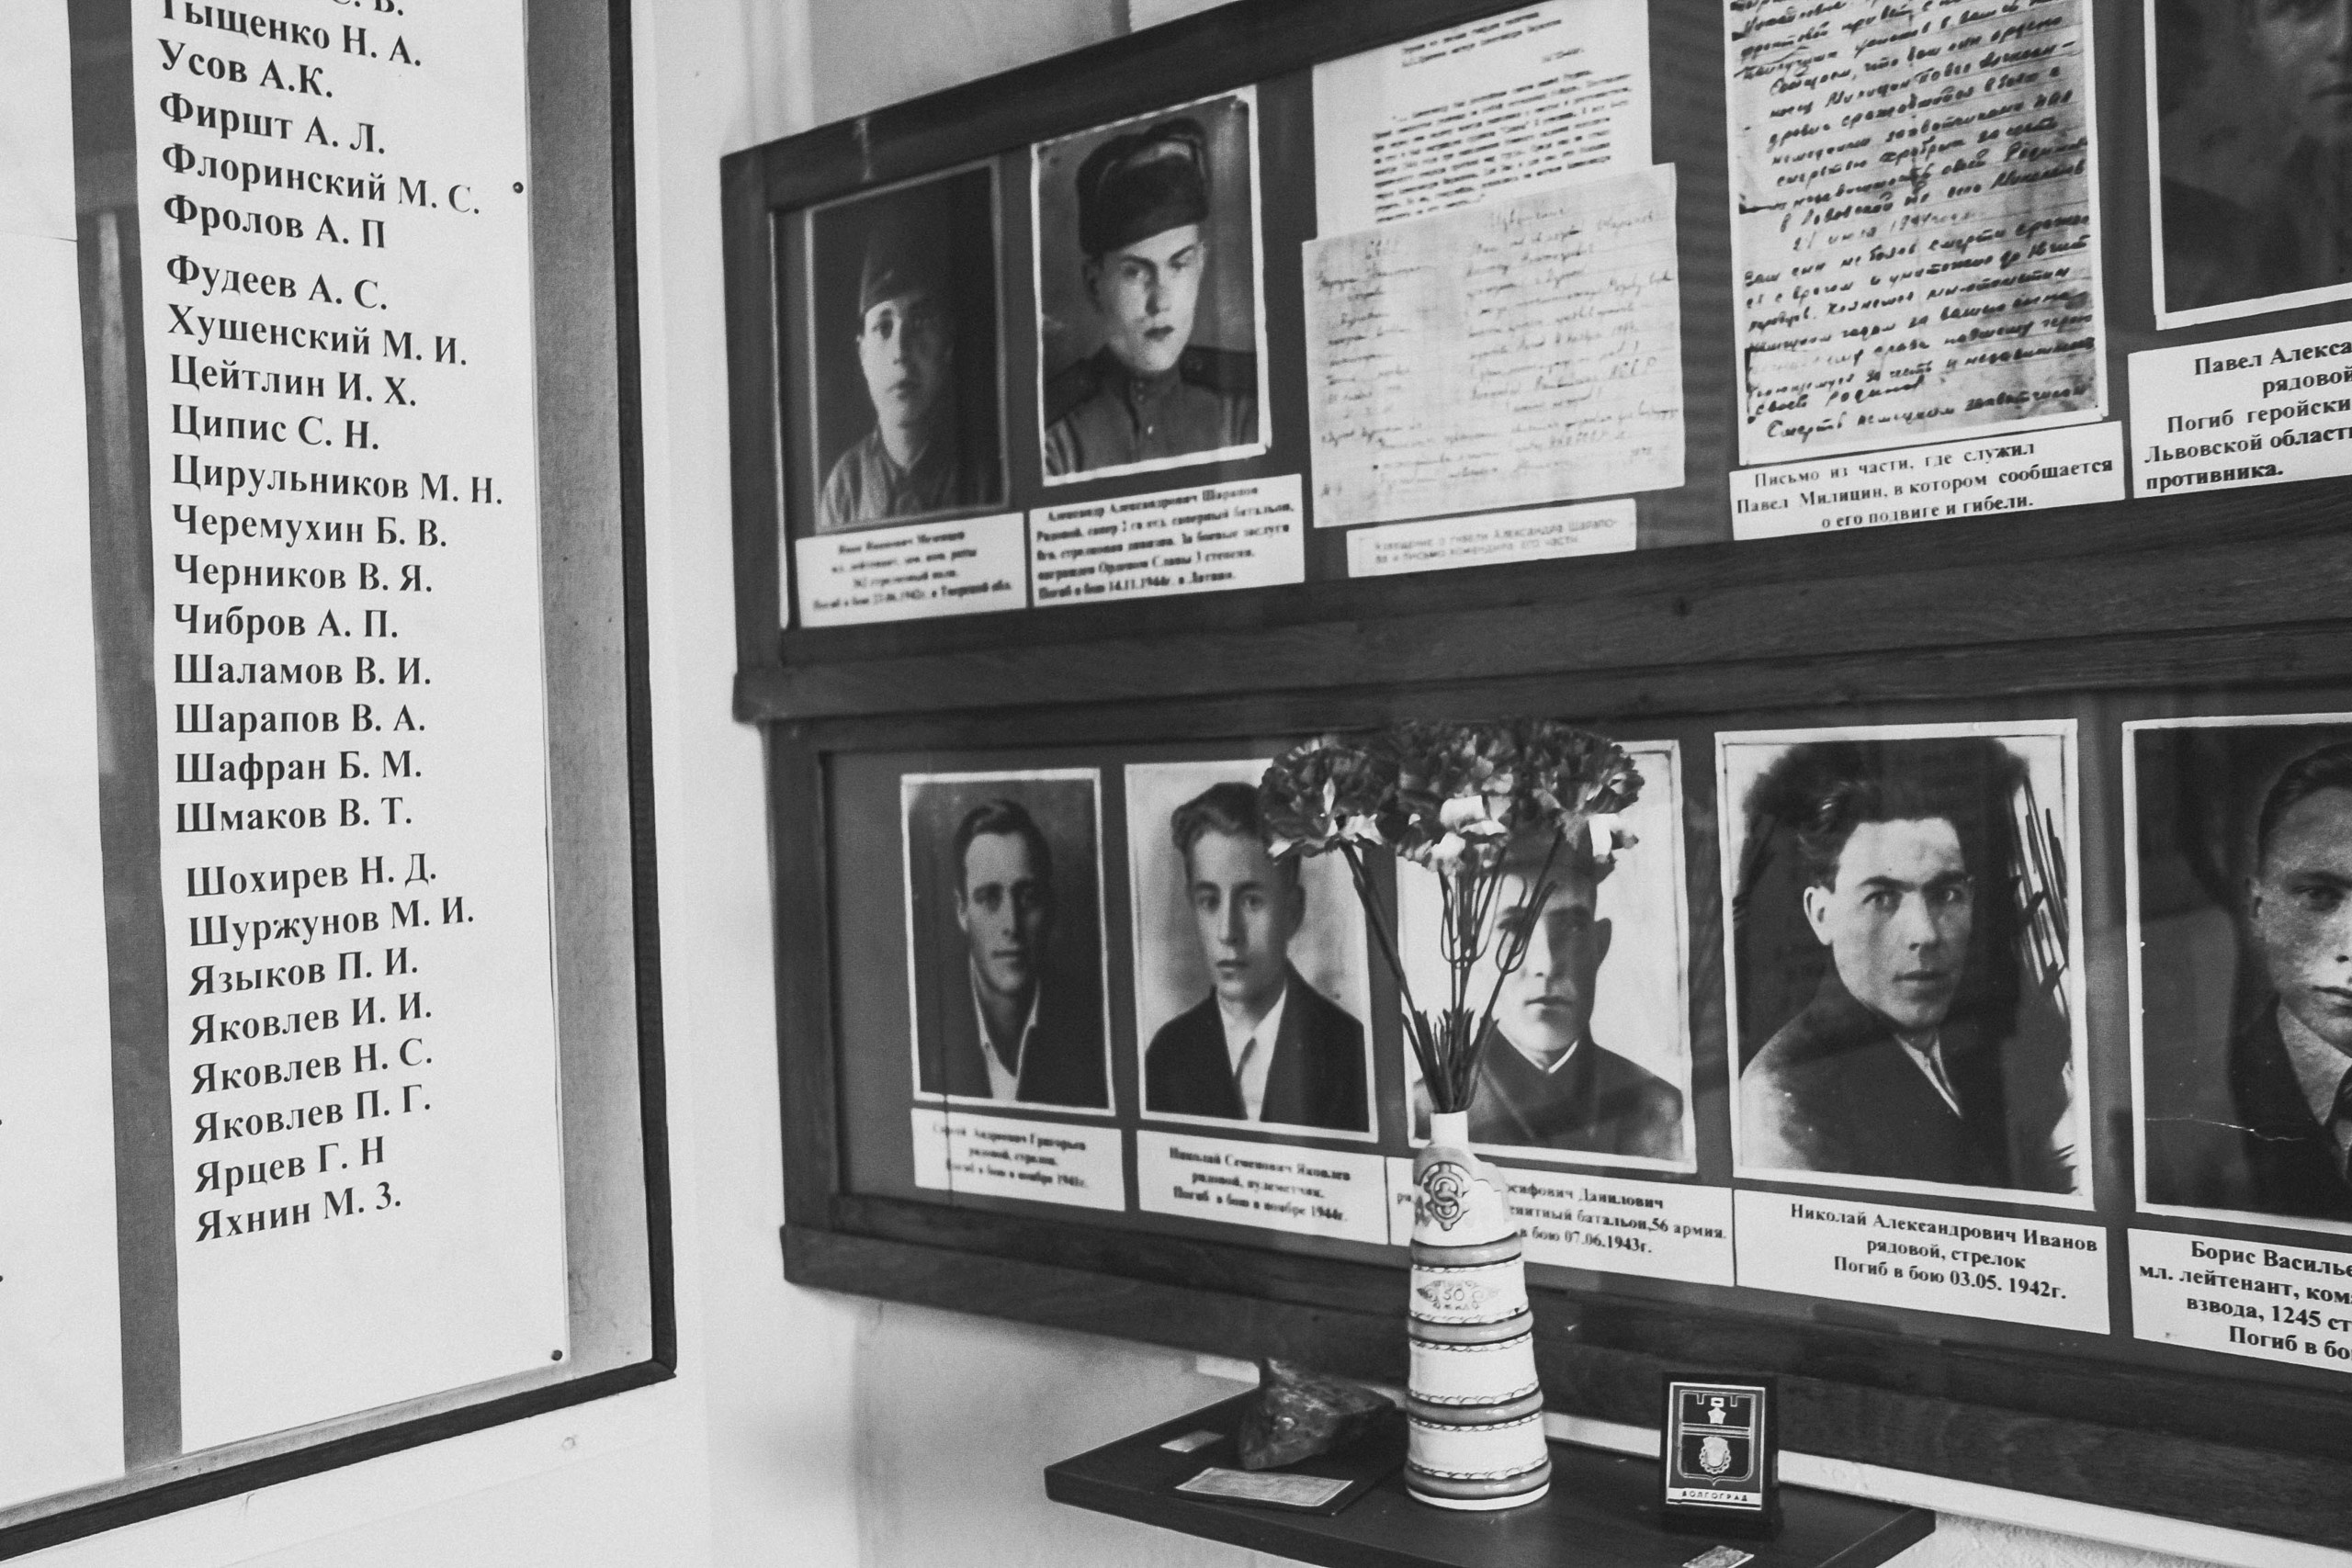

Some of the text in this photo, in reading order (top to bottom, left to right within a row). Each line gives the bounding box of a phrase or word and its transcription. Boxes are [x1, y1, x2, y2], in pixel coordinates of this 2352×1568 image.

[158, 39, 248, 83] Усов
[342, 23, 379, 60] Н.
[387, 34, 423, 68] А.
[160, 92, 385, 154] Фиршт А. Л.
[162, 142, 480, 215] Флоринский М. С.
[164, 194, 385, 249] Фролов А. П
[166, 254, 387, 310] Фудеев А. С.
[167, 303, 467, 366] Хушенский М. И.
[171, 354, 416, 407] Цейтлин И. Х.
[2195, 355, 2262, 376] Павел
[172, 403, 379, 450] Ципис С. Н.
[2167, 398, 2351, 434] Погиб геройски
[1755, 443, 2034, 488] Письмо из части, где служил
[2144, 434, 2262, 464] Львовской
[173, 454, 502, 505] Цирульников М. Н.
[1736, 499, 1789, 514] Павел
[1800, 488, 1888, 506] Милицин,
[1894, 485, 1904, 496] в
[1909, 475, 1987, 494] котором
[2145, 463, 2285, 494] противника.
[173, 503, 447, 548] Черемухин Б. В.
[1836, 513, 1864, 528] его
[1869, 506, 1940, 525] подвиге
[1946, 503, 1957, 516] и
[1962, 494, 2035, 514] гибели.
[174, 554, 432, 594] Черников В. Я.
[174, 604, 398, 644] Чибров А. П.
[174, 653, 431, 685] Шаламов В. И.
[175, 704, 425, 742] Шарапов В. А.
[175, 750, 422, 791] Шафран Б. М.
[176, 796, 412, 833] Шмаков В. Т.
[187, 852, 436, 898] Шохирев Н. Д.
[189, 896, 474, 952] Шуржунов М. И.
[188, 946, 418, 997] Языков П. И.
[189, 991, 432, 1045] Яковлев И. И.
[191, 1038, 432, 1095] Яковлев Н. С.
[193, 1084, 431, 1145] Яковлев П. Г.
[195, 1135, 384, 1197] Ярцев Г. Н
[196, 1181, 401, 1243] Яхнин М. З.
[1578, 1188, 1664, 1210] Данилович
[1532, 1225, 1561, 1243] бою
[1673, 1224, 1723, 1239] армия.
[1791, 1202, 2098, 1252] Николай Александрович Иванов
[1867, 1240, 2027, 1269] рядовой, стрелок
[2191, 1240, 2256, 1266] Борис
[1834, 1255, 2066, 1300] Погиб в бою 03.05. 1942г.
[2139, 1265, 2352, 1305] мл. лейтенант, ком
[2187, 1297, 2265, 1322] взвода,
[2272, 1304, 2322, 1328] 1245
[2229, 1325, 2351, 1360] Погиб в бо
